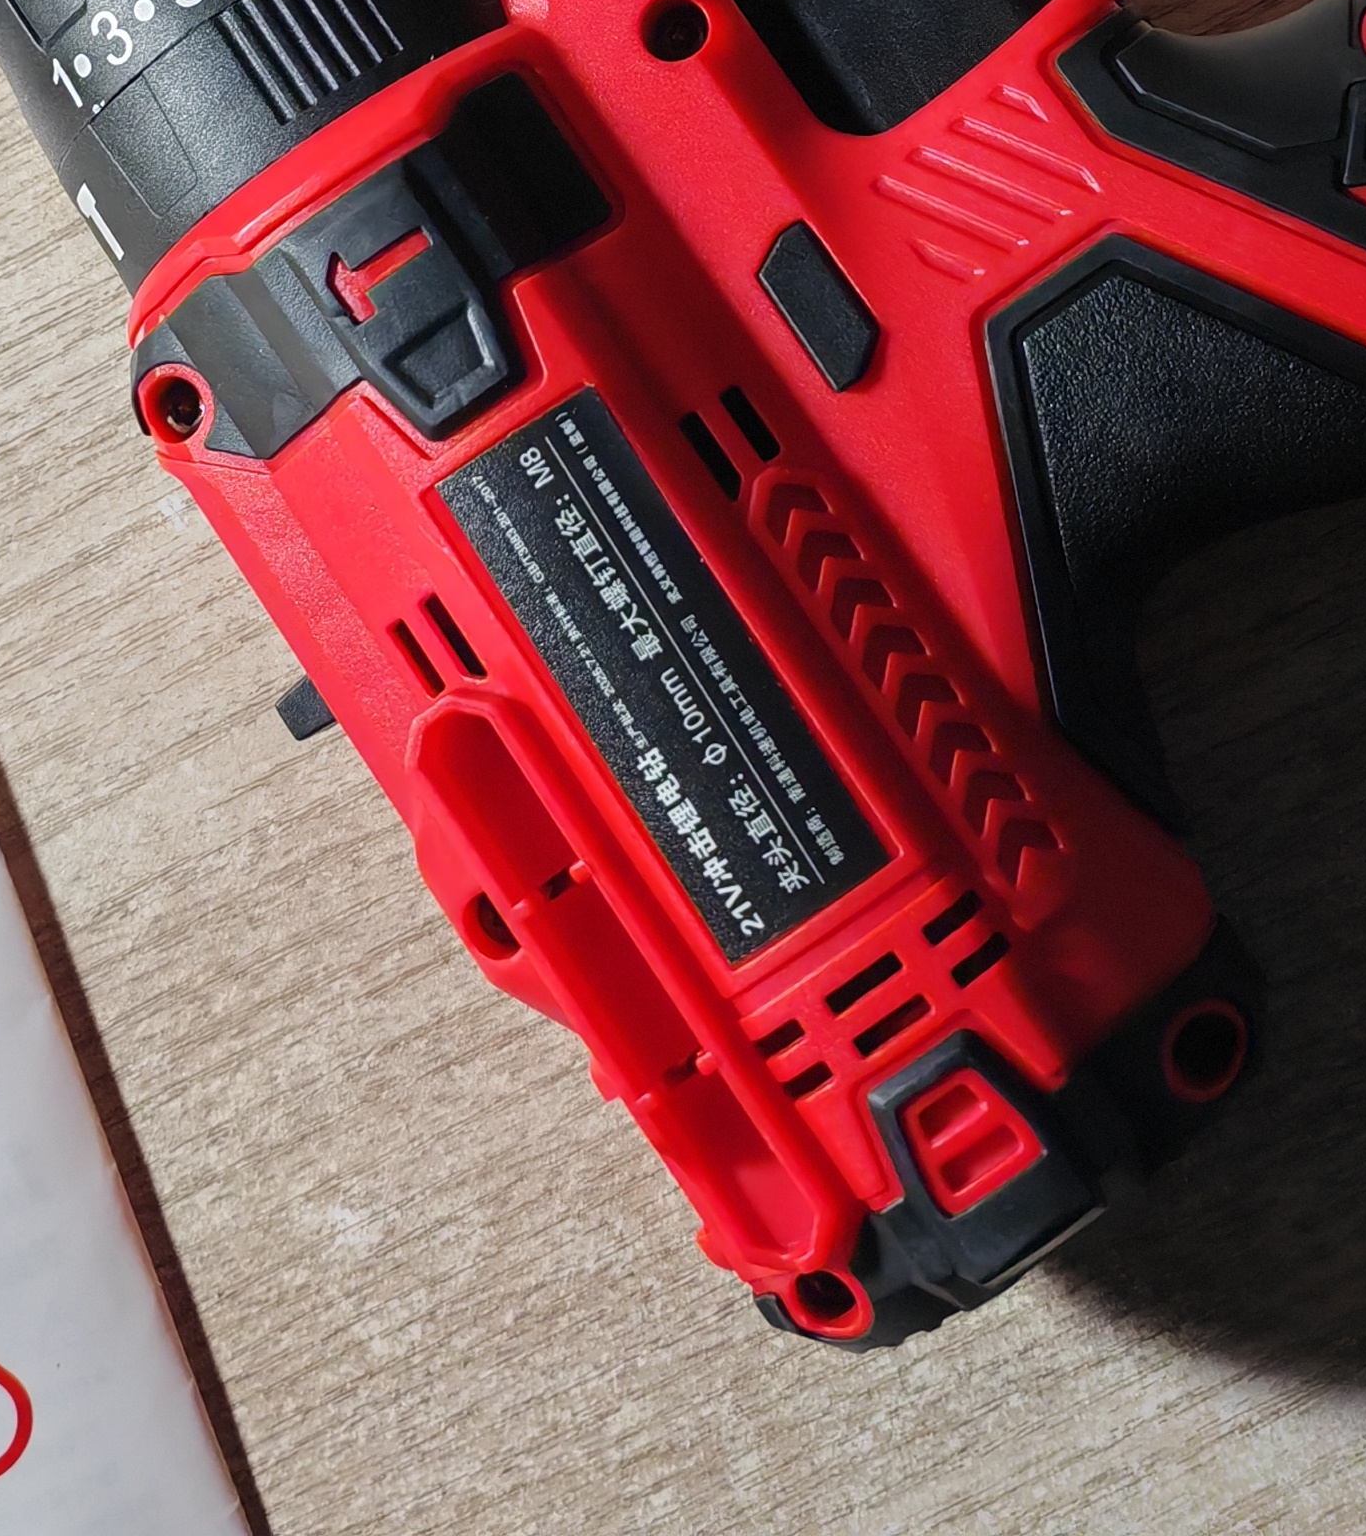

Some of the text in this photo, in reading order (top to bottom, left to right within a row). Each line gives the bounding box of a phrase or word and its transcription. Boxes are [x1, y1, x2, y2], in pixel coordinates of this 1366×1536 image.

[53, 58, 83, 108] 1
[91, 10, 134, 65] 3
[635, 746, 764, 937] 21V冲击锂电钻
